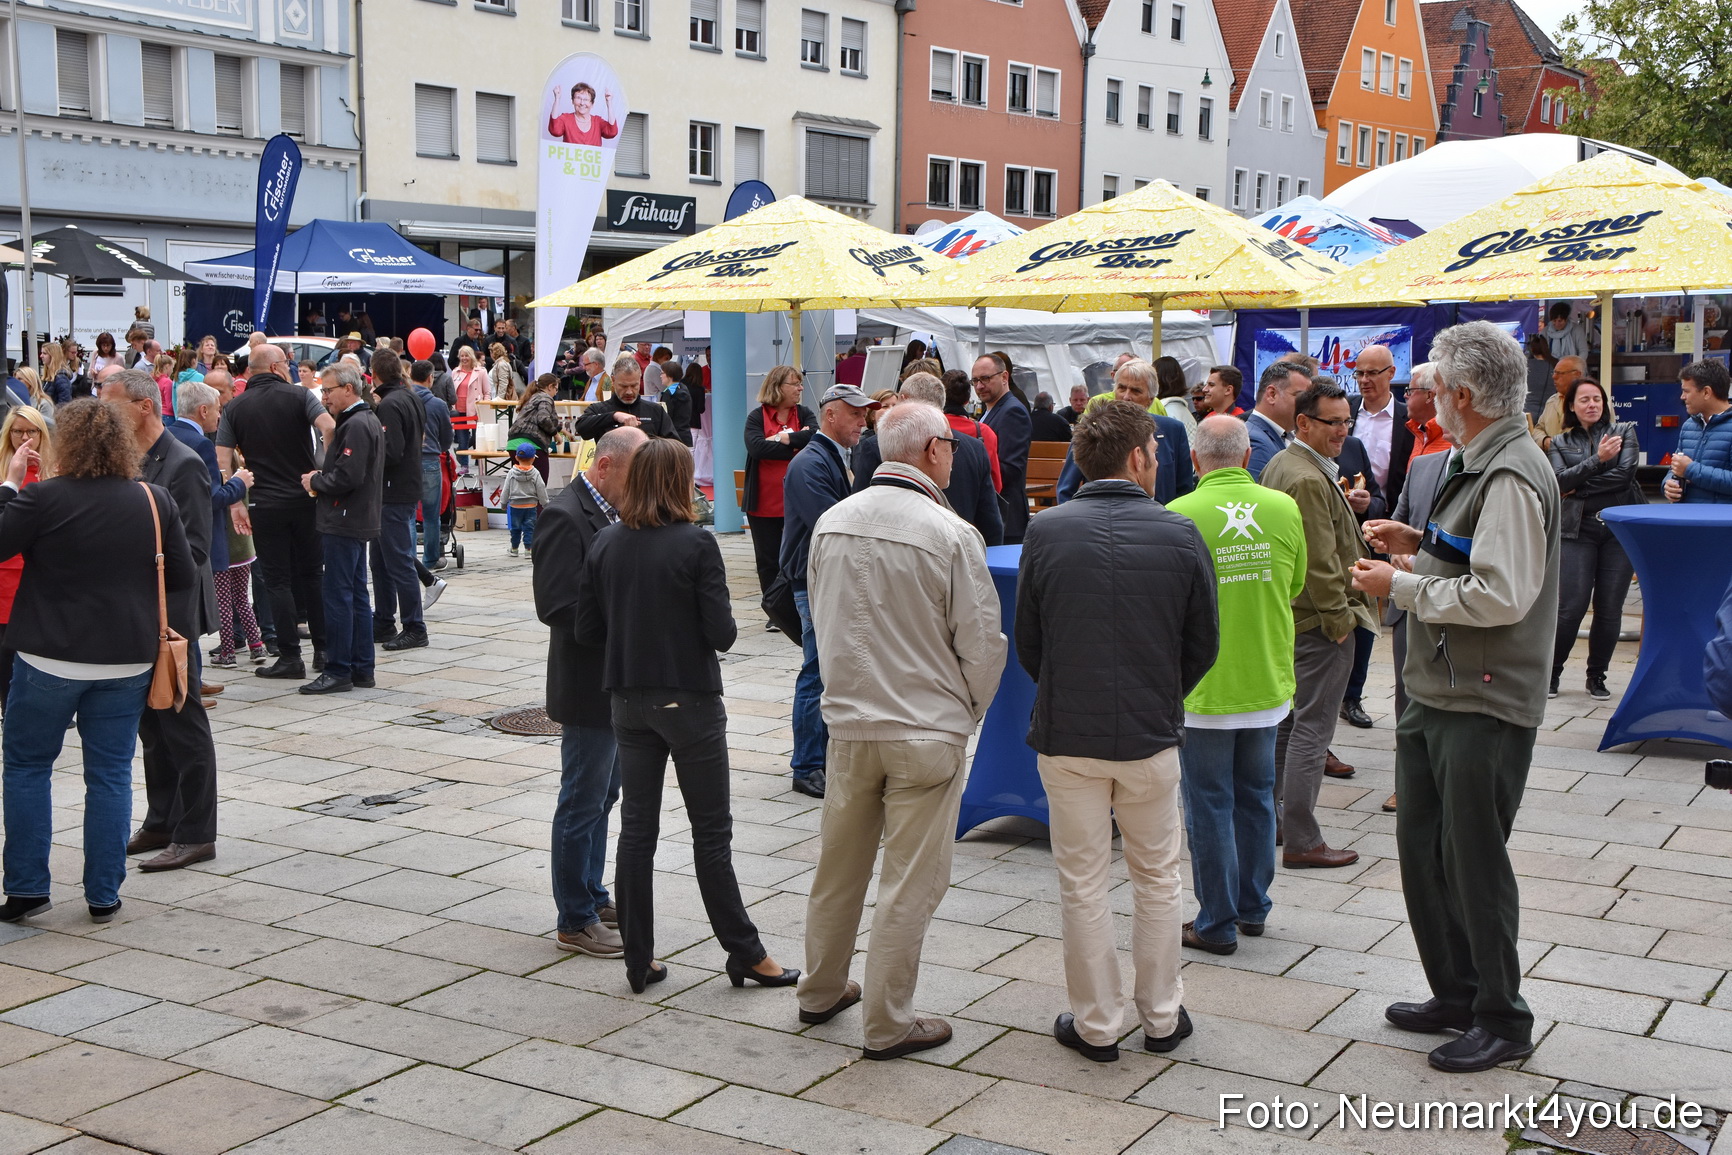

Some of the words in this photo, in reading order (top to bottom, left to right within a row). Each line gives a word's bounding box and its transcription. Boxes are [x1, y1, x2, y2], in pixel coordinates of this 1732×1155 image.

[548, 145, 602, 164] PFLEGE
[563, 162, 576, 175] &
[580, 163, 601, 178] DU
[270, 151, 289, 211] Fischer
[279, 160, 294, 208] AUTOMOBILE
[612, 195, 694, 231] frühauf
[1015, 229, 1196, 273] Glossner
[1444, 210, 1663, 273] Glossner
[359, 251, 414, 264] Fischer
[646, 240, 799, 281] Glossner
[849, 245, 924, 278] Glossner
[1094, 252, 1173, 269] Bier
[1539, 242, 1638, 263] Bier
[705, 262, 769, 277] Bier
[1543, 265, 1660, 280] Biergenuss
[1216, 542, 1270, 555] DEUTSCHLAND
[1217, 552, 1249, 563] BEWEGT
[1251, 551, 1271, 560] SICH!
[1220, 573, 1259, 584] BARMER
